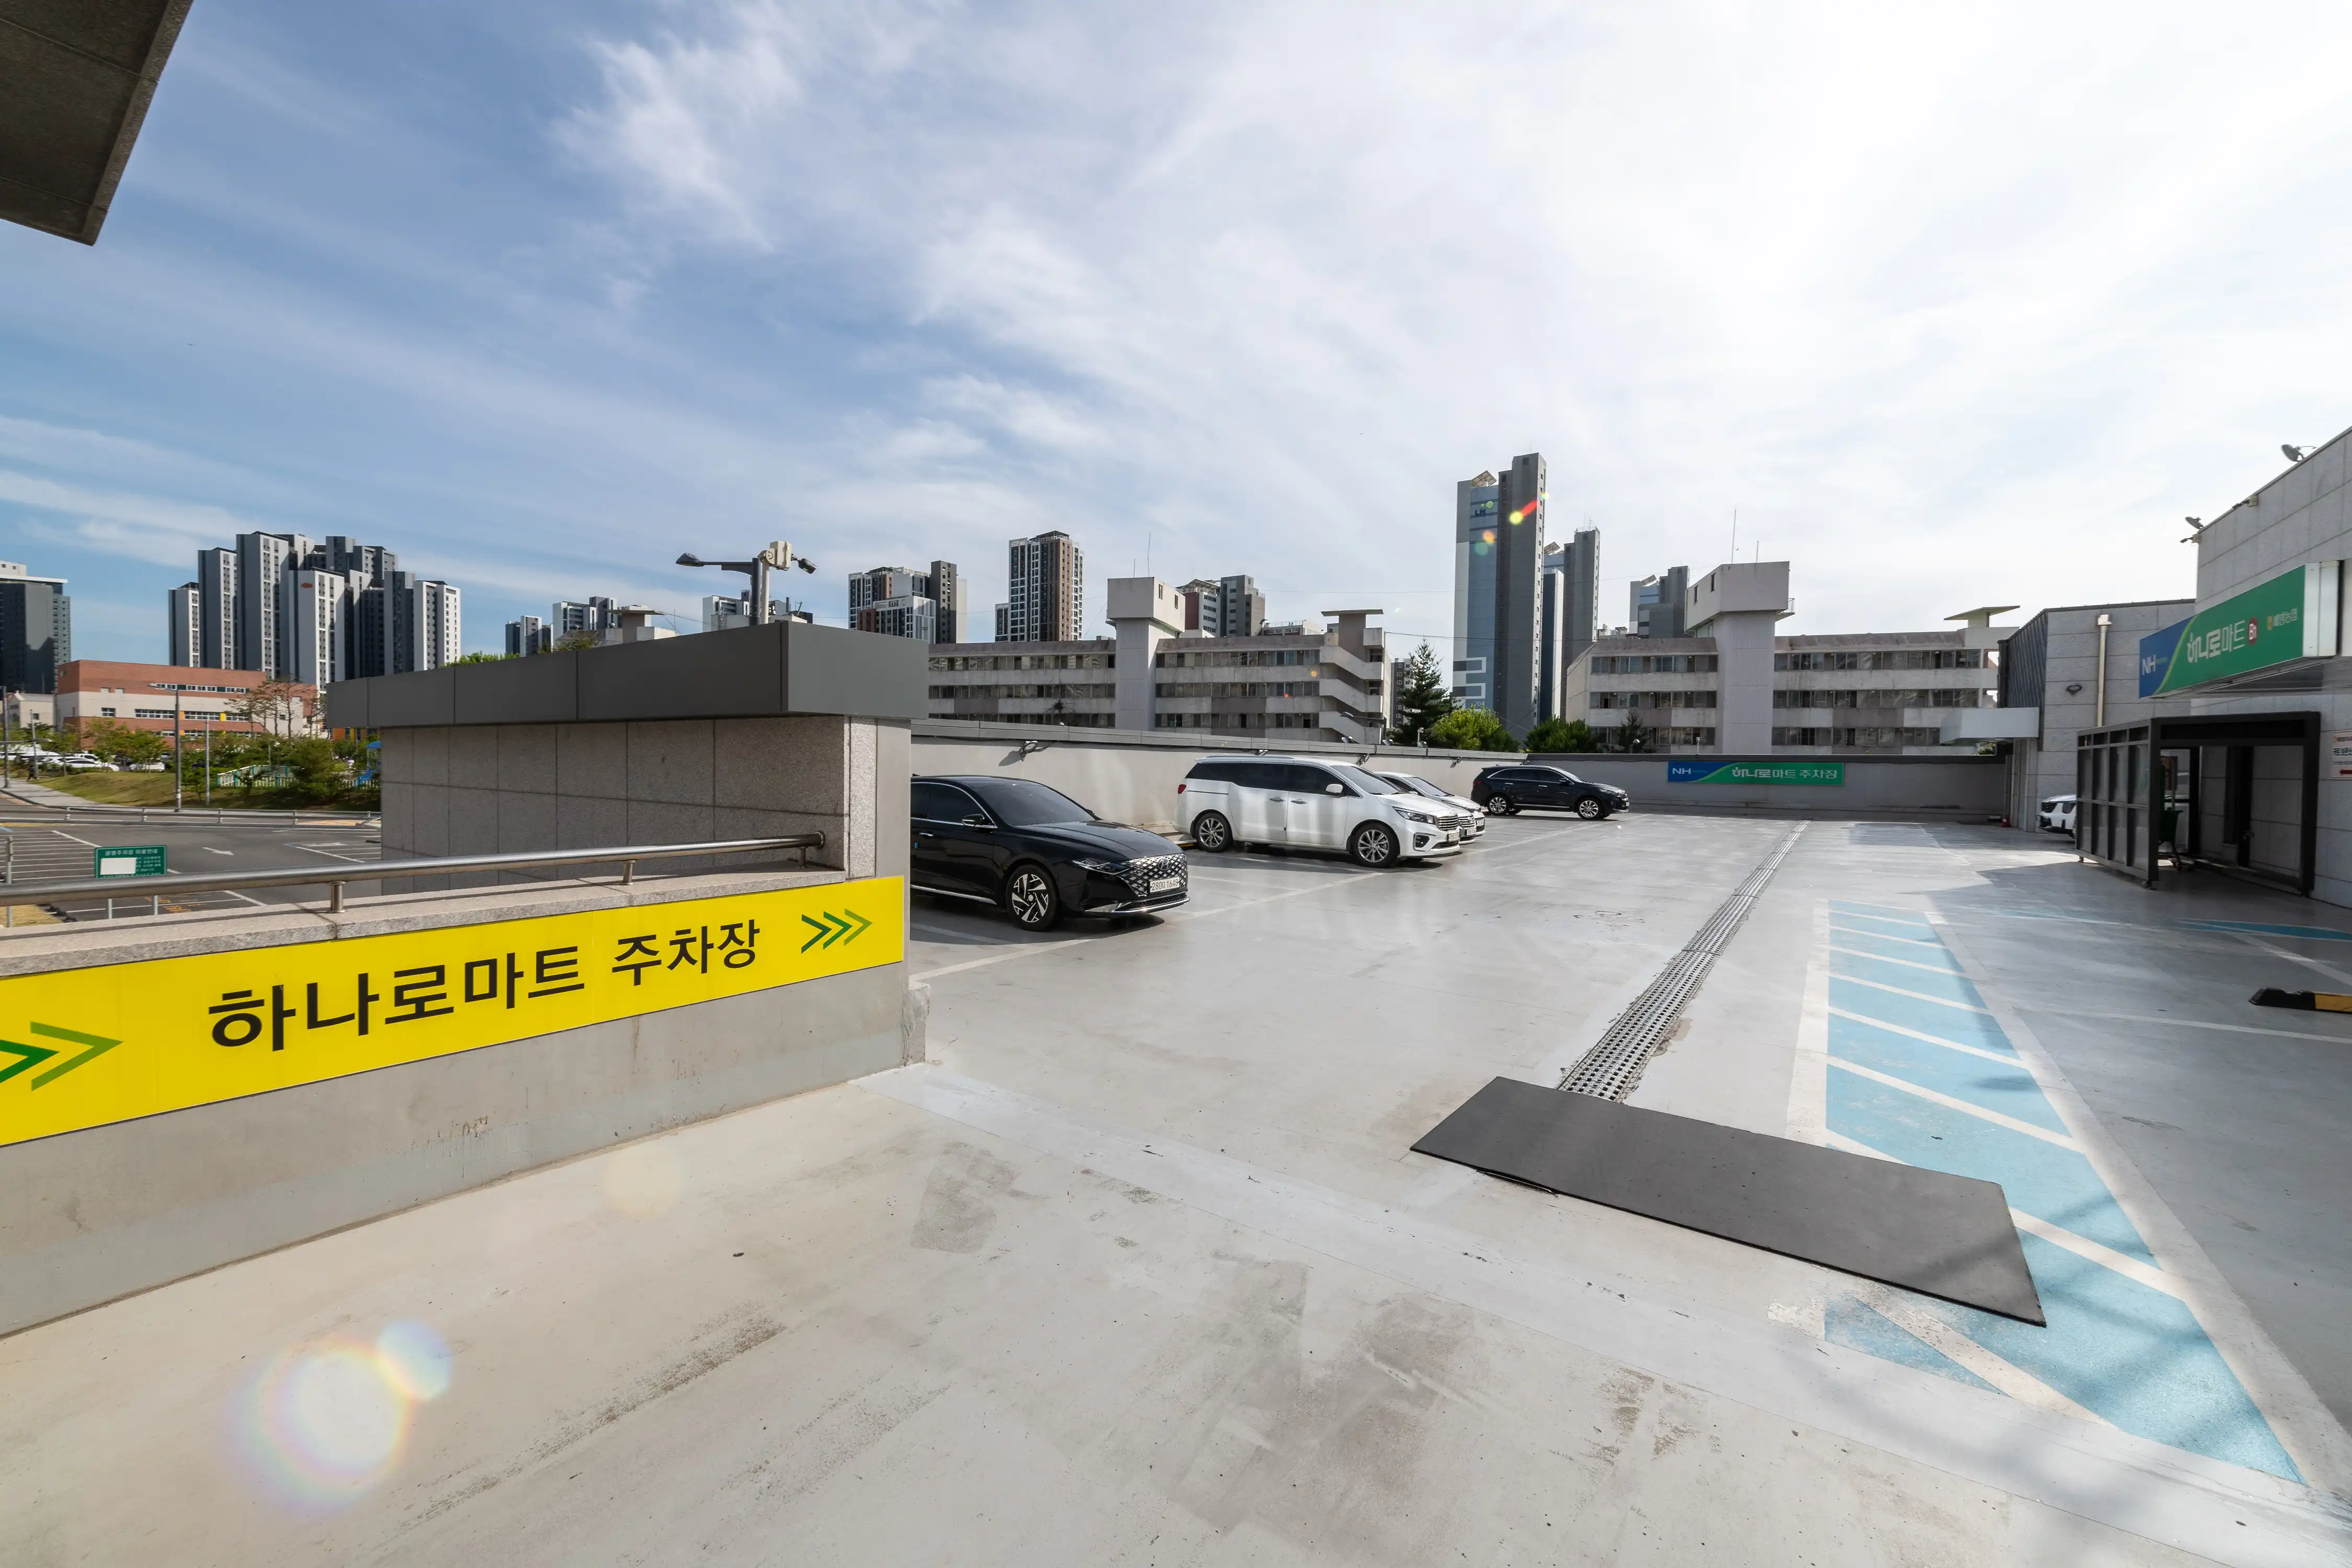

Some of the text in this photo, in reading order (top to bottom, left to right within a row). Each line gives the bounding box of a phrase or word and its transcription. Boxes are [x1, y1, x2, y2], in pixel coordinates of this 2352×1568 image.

[2142, 654, 2156, 675] NH
[2187, 620, 2245, 663] 하나로마트
[2249, 623, 2257, 640] B1
[1732, 767, 1796, 779] 하나로마트
[1800, 769, 1838, 779] 주차장
[209, 919, 760, 1052] 하나로마트 주차장
